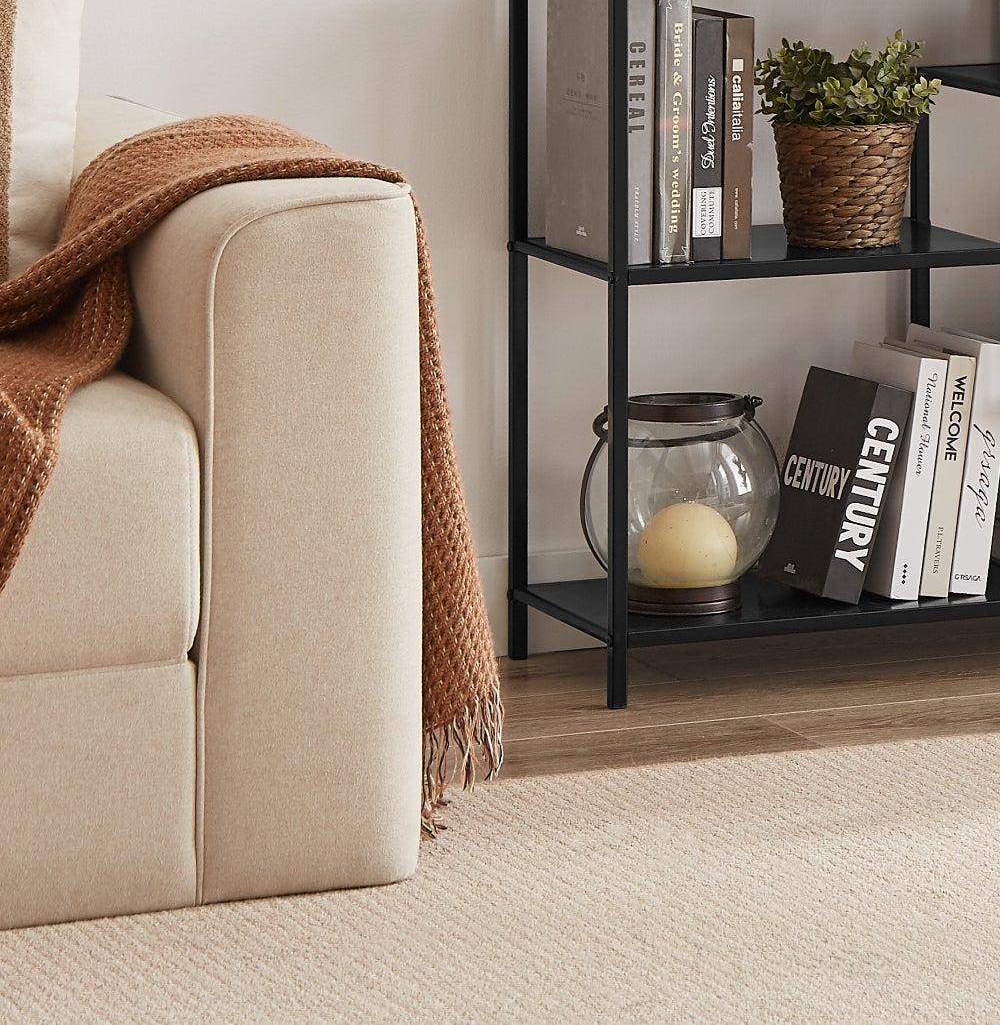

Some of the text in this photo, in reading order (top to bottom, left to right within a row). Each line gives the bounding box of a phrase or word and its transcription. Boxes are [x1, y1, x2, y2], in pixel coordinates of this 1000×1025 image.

[673, 22, 684, 67] Bride
[628, 41, 646, 134] CEREAL
[673, 71, 683, 86] &
[731, 75, 744, 142] caliaitalia
[668, 166, 683, 234] wedding
[944, 375, 968, 462] WELCOME
[783, 454, 851, 500] CENTURY
[834, 417, 900, 573] CENTURY
